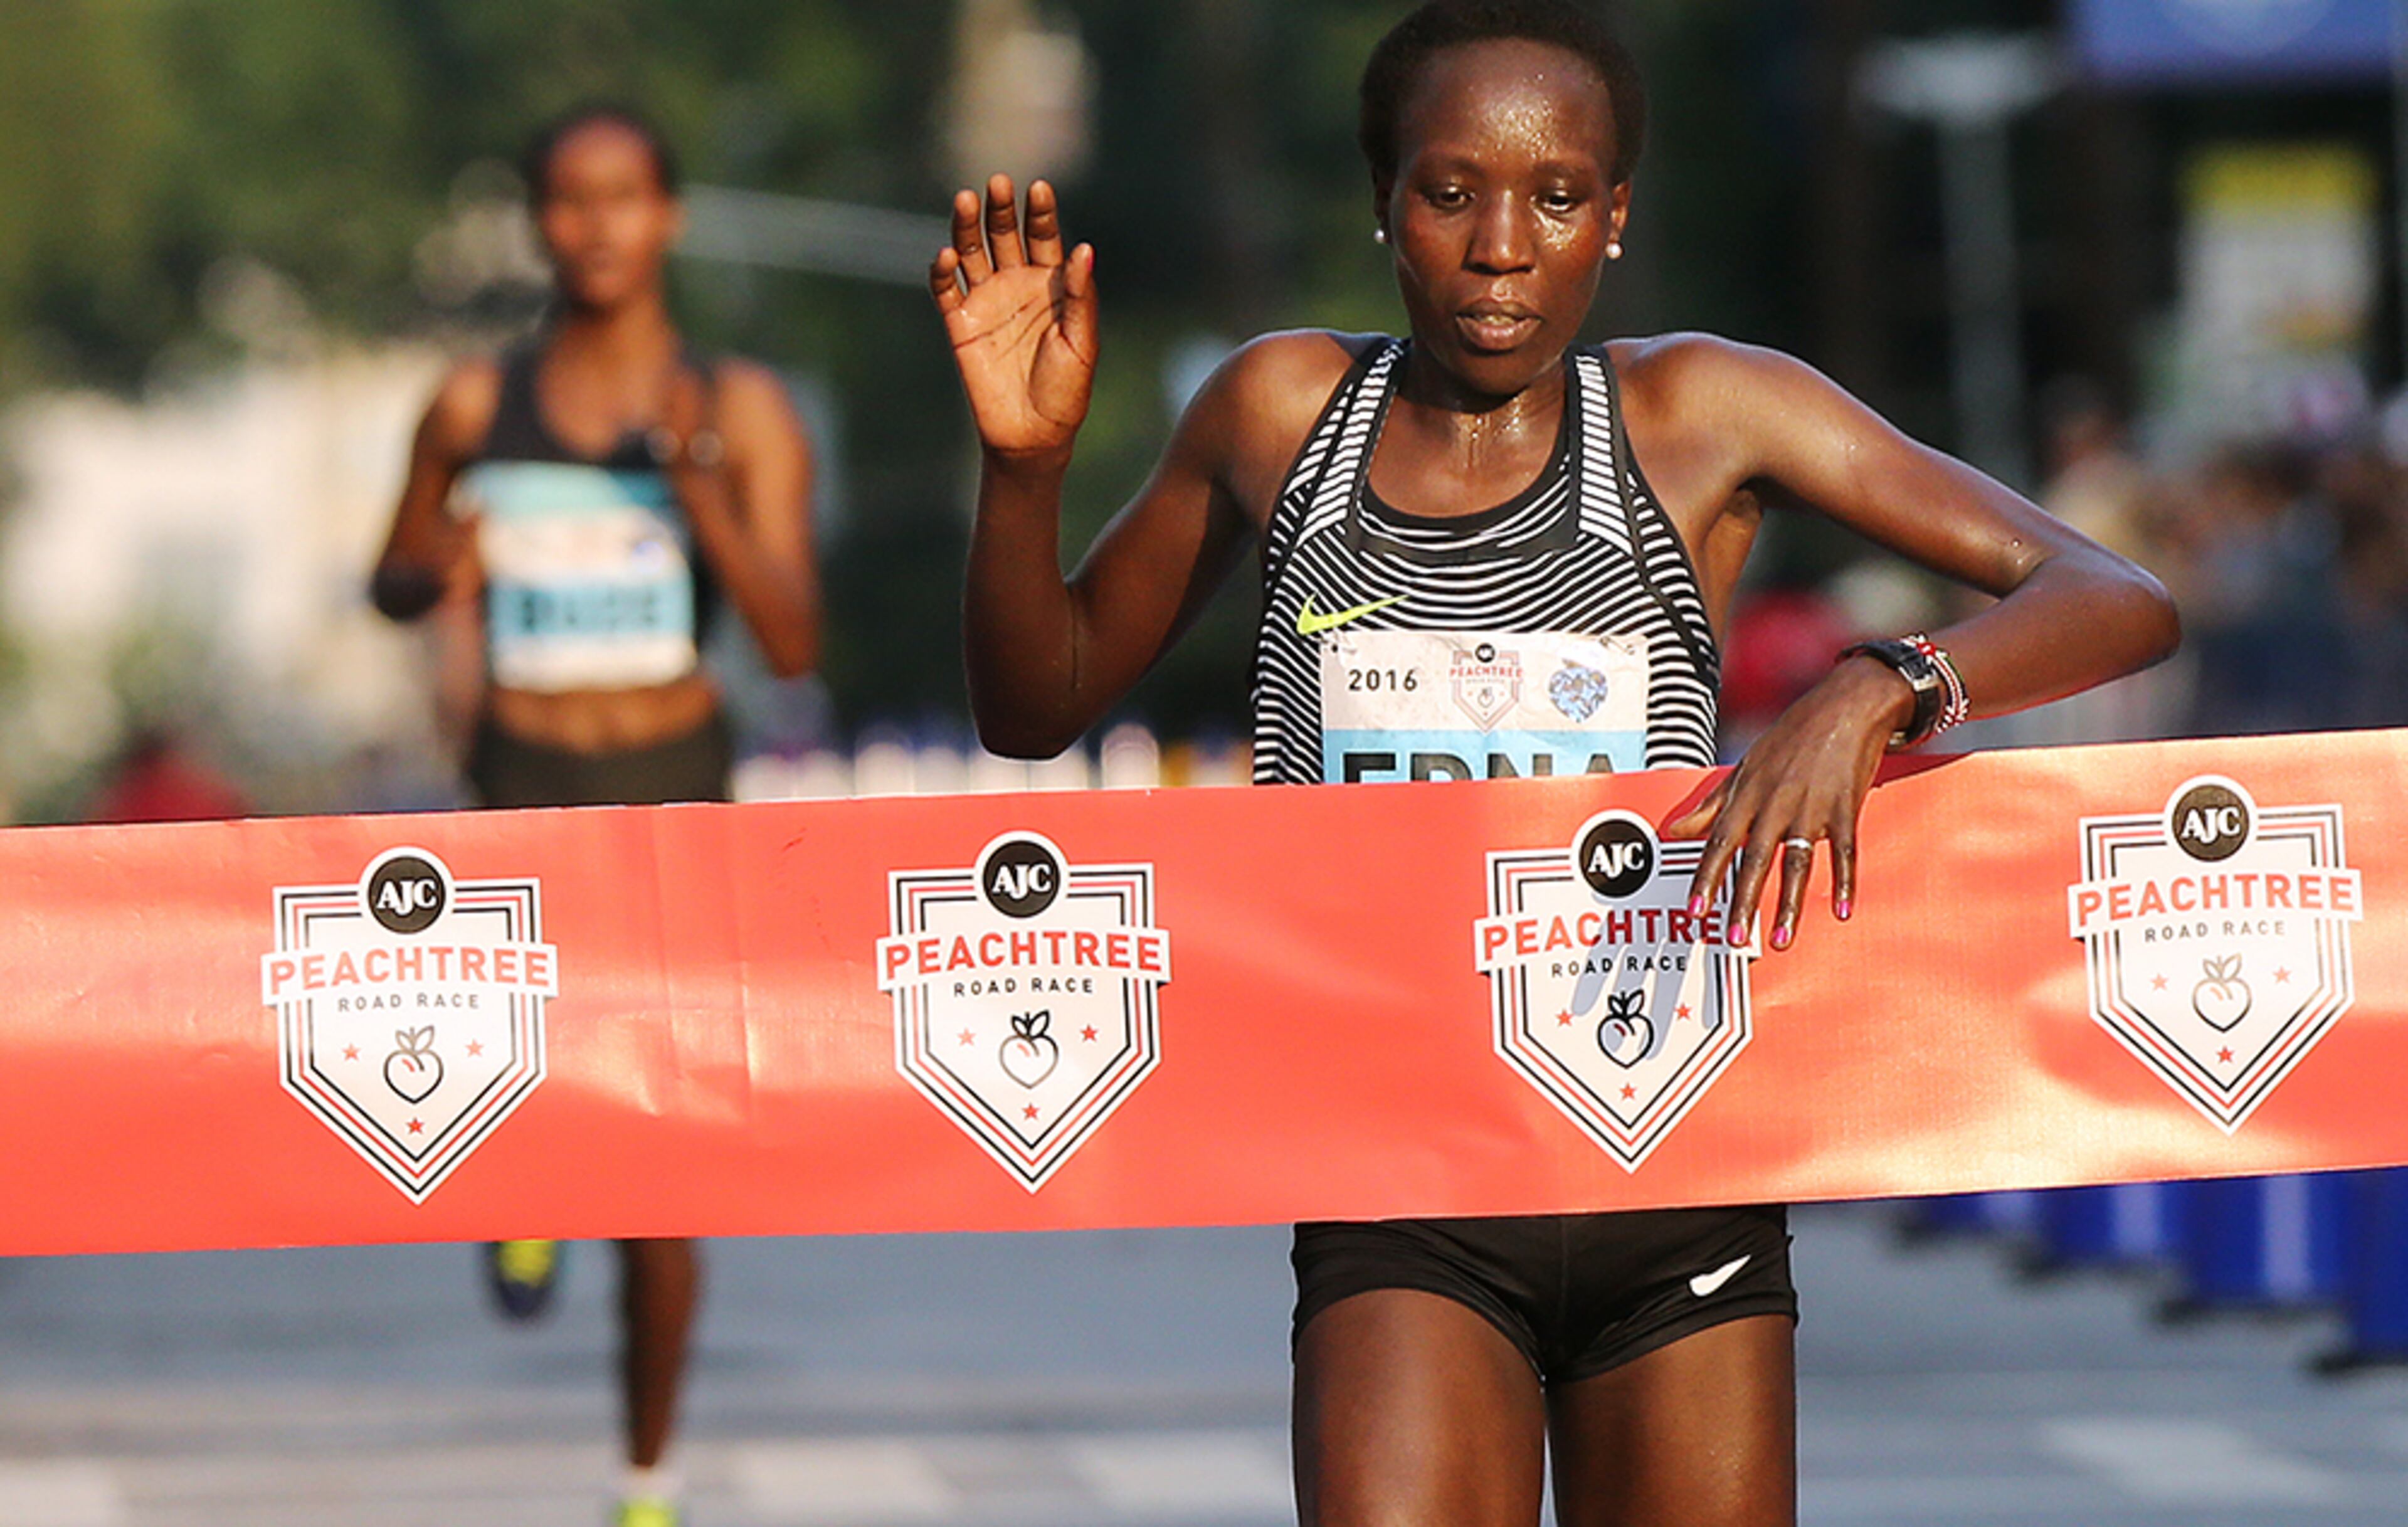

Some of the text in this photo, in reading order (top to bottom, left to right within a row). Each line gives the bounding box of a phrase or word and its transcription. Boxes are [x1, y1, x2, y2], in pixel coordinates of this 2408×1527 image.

[1348, 669, 1418, 691] 2016
[2182, 807, 2241, 843] AJC
[1588, 842, 1645, 878] AJC
[376, 879, 437, 915] AJC
[992, 864, 1051, 899] AJC
[2077, 874, 2354, 927] PEACHTREE
[1483, 909, 1752, 961] PEACHTRE
[2145, 921, 2286, 942] ROAD RACE
[270, 946, 549, 995] PEACHTREE
[885, 931, 1162, 980] PEACHTREE
[1551, 956, 1687, 976] ROAD RACE
[339, 993, 479, 1011] ROAD RACE
[953, 977, 1094, 997] ROAD RACE
